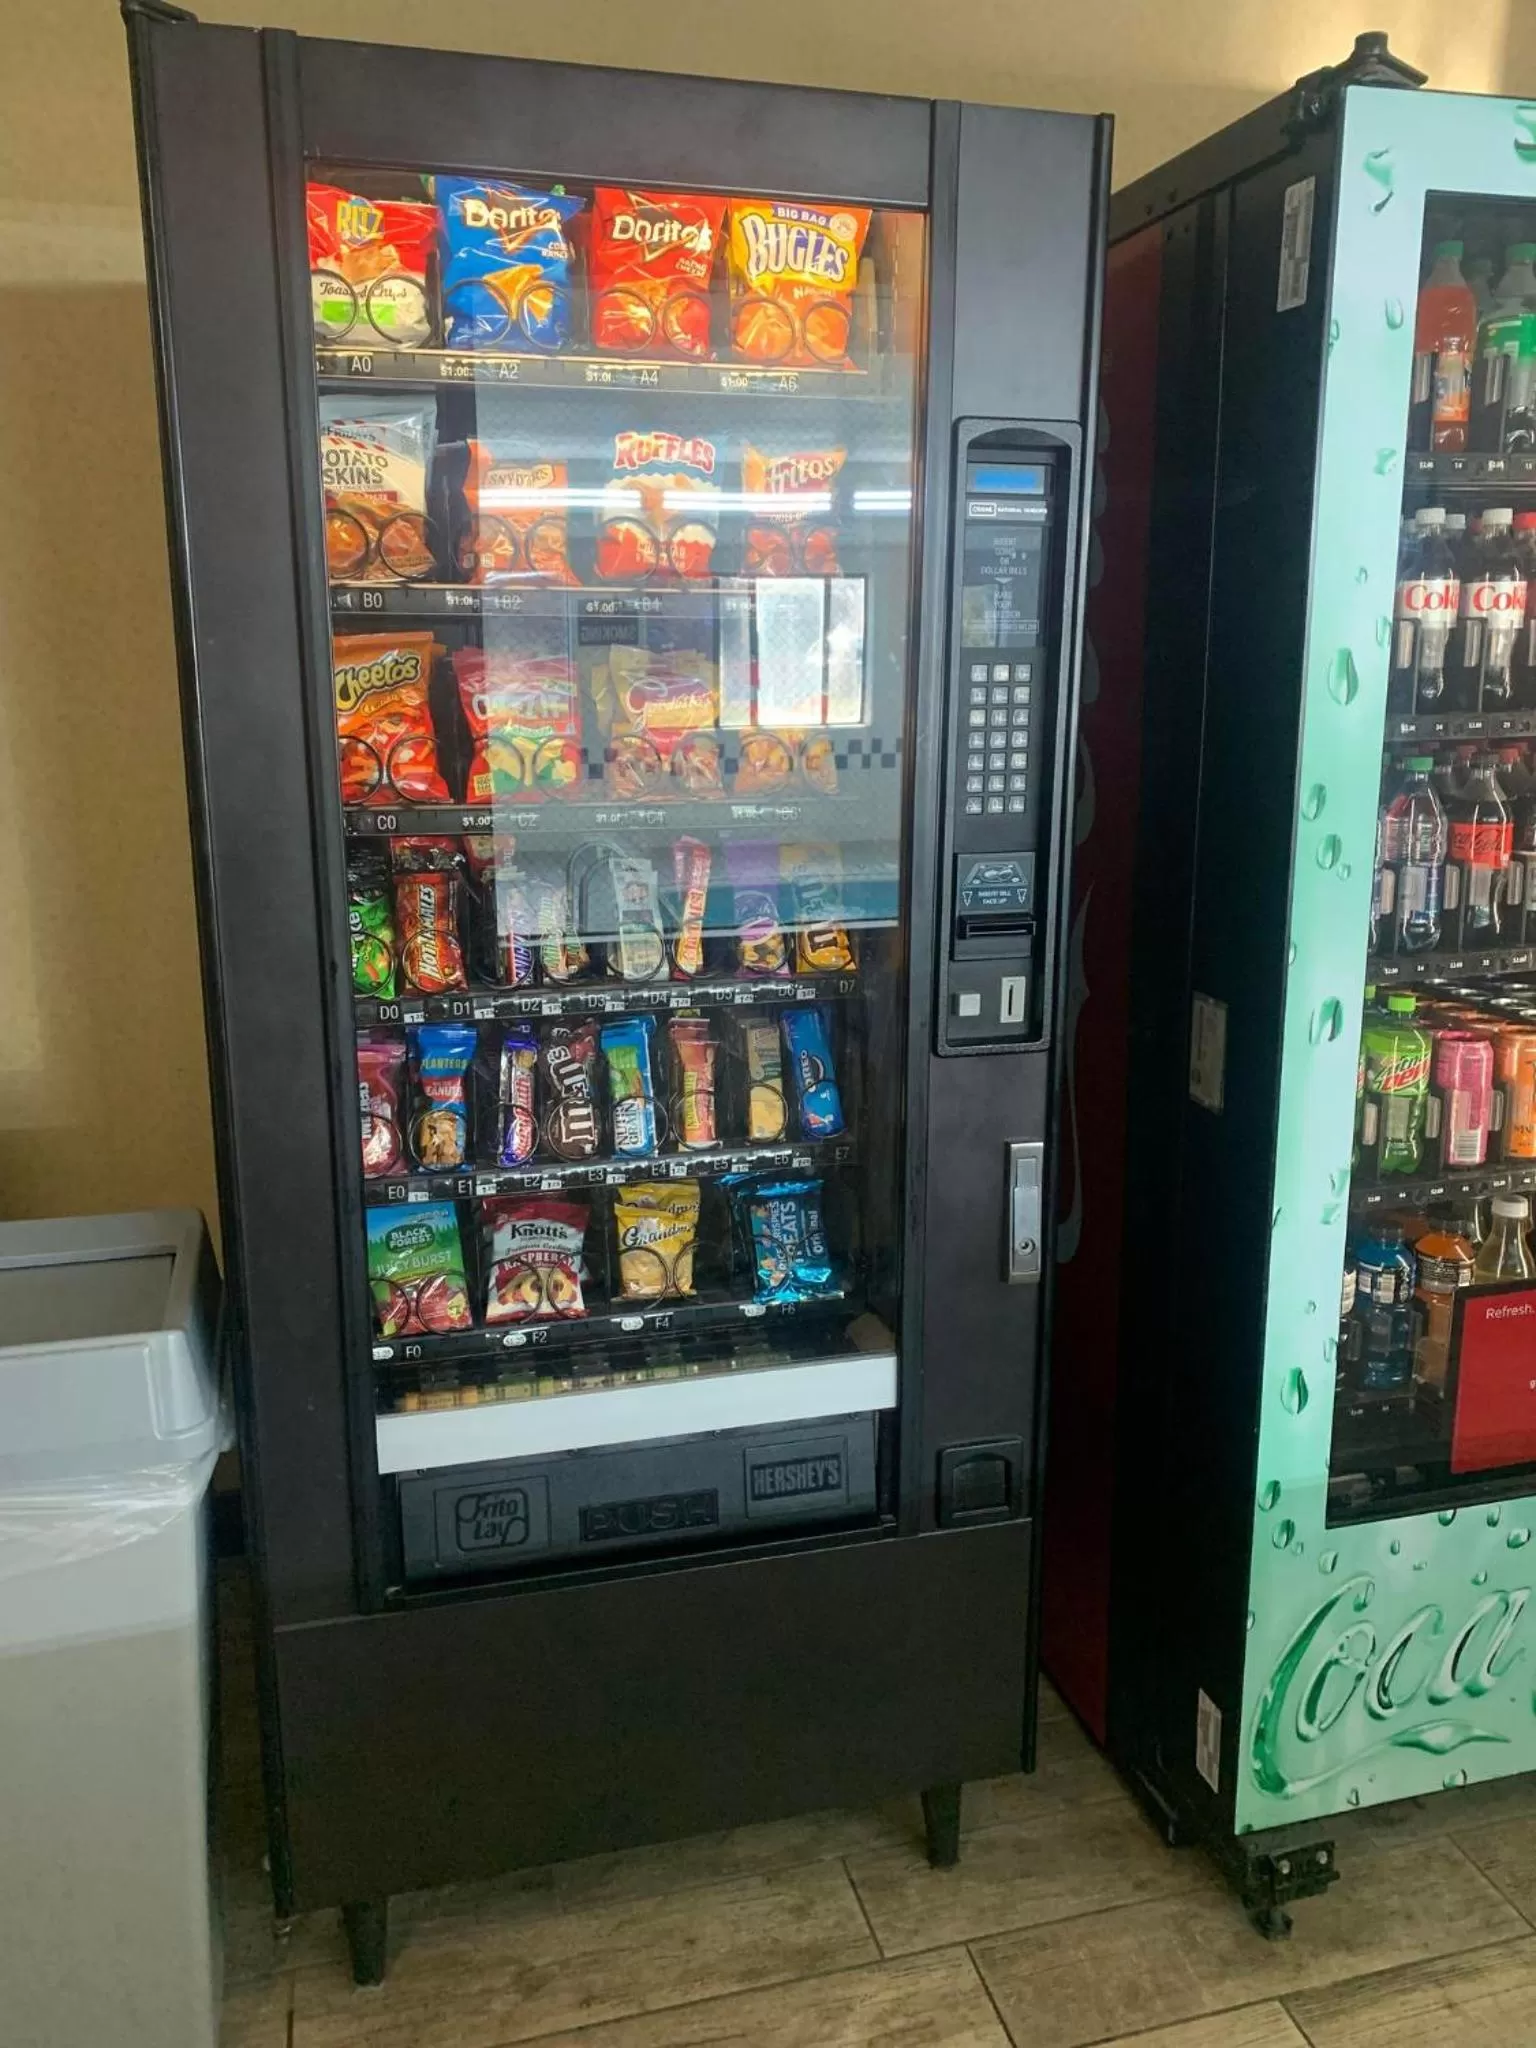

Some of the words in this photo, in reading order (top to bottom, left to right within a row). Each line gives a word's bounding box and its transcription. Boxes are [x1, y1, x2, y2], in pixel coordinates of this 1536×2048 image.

[336, 200, 384, 239] RITZ
[777, 207, 799, 220] BIG
[800, 211, 827, 226] BAG
[740, 214, 849, 283] BUGLES
[352, 356, 371, 373] A0
[499, 364, 519, 379] A2
[641, 371, 659, 384] A4
[779, 375, 797, 391] A6
[325, 448, 389, 469] OTATO
[613, 432, 716, 474] RUFFLES
[322, 466, 385, 486] SKINS
[363, 593, 383, 608] B0
[334, 655, 420, 713] Cheetos
[377, 815, 396, 830] C0
[419, 943, 444, 981] HOT
[839, 980, 855, 994] D7
[521, 999, 540, 1012] D2
[588, 994, 606, 1008] D3
[650, 992, 667, 1004] D4
[379, 1005, 399, 1020] D0
[453, 1001, 470, 1016] D1
[800, 1049, 817, 1092] OREO
[626, 1102, 641, 1146] GRAIN
[588, 1168, 605, 1182] E3
[651, 1162, 666, 1176] E4
[457, 1179, 473, 1195] E1
[523, 1175, 540, 1188] E2
[387, 1185, 405, 1200] E0
[390, 1226, 428, 1241] BLACK
[511, 1223, 569, 1240] Knott's
[389, 1234, 432, 1249] FOREST
[412, 1250, 452, 1267] BURST
[1485, 1303, 1536, 1320] Refresh.
[753, 1458, 840, 1496] HERSHEY'S
[586, 1494, 717, 1541] PUSH
